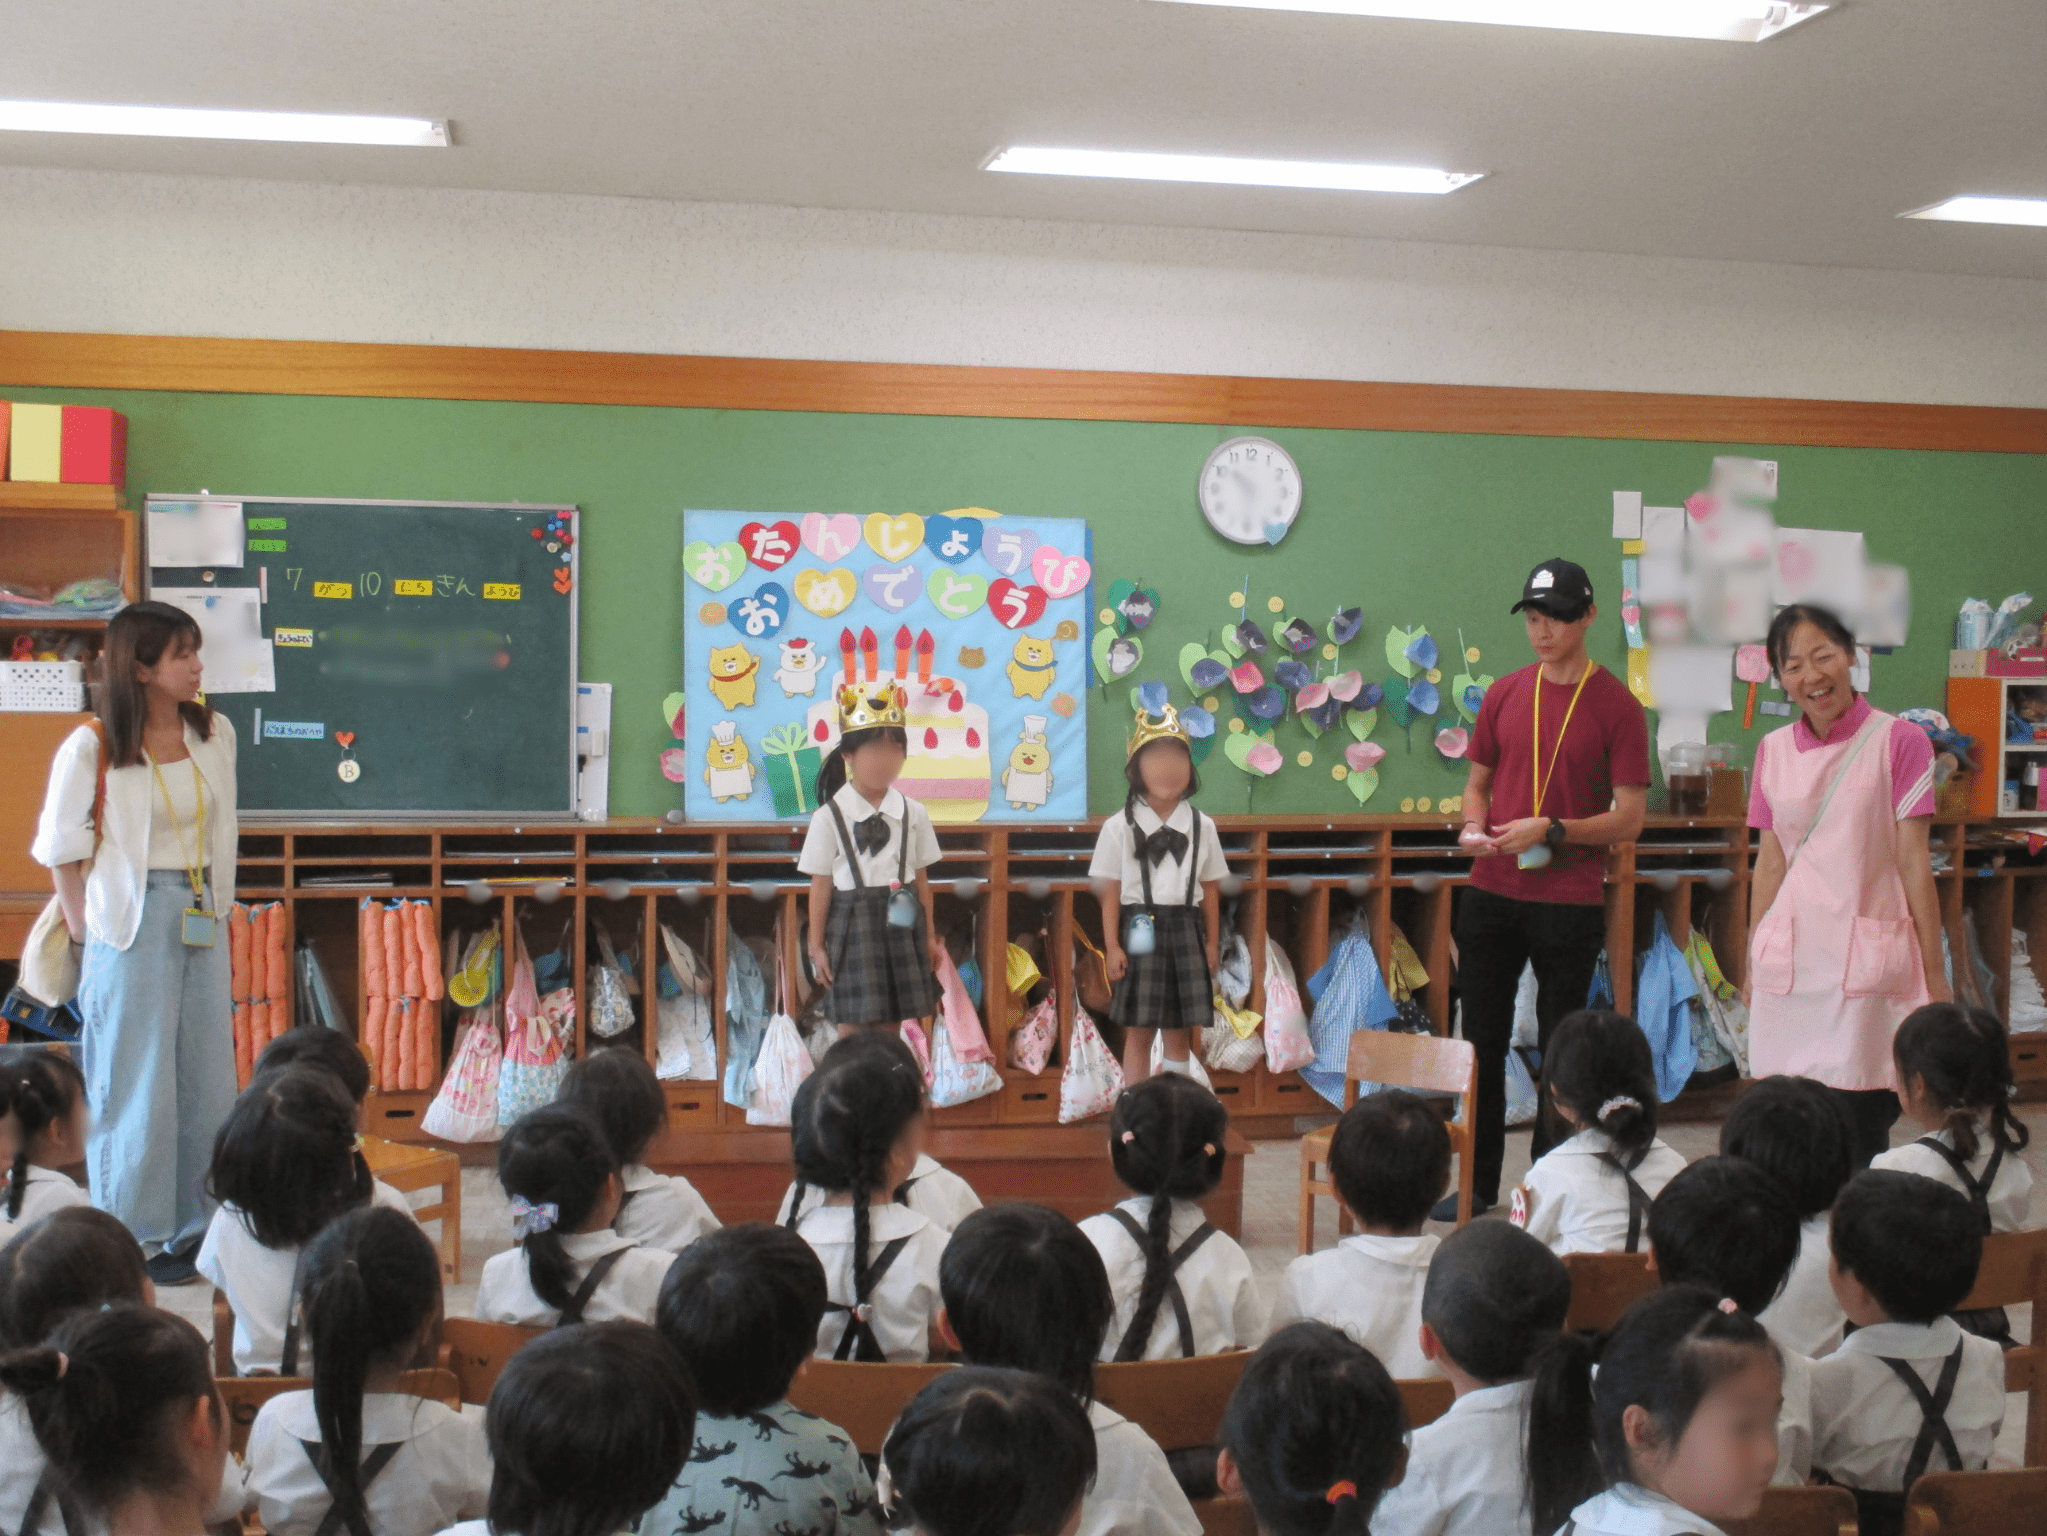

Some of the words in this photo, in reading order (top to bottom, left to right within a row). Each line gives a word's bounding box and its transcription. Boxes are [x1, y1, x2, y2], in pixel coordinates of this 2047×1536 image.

[1230, 452, 1239, 464] 11
[1246, 448, 1257, 461] 12
[696, 519, 1077, 596] おたんじょうび
[286, 567, 302, 590] 7
[360, 571, 382, 597] 10
[436, 574, 476, 598] きん
[738, 565, 1030, 634] おめでとう
[344, 764, 354, 778] B
